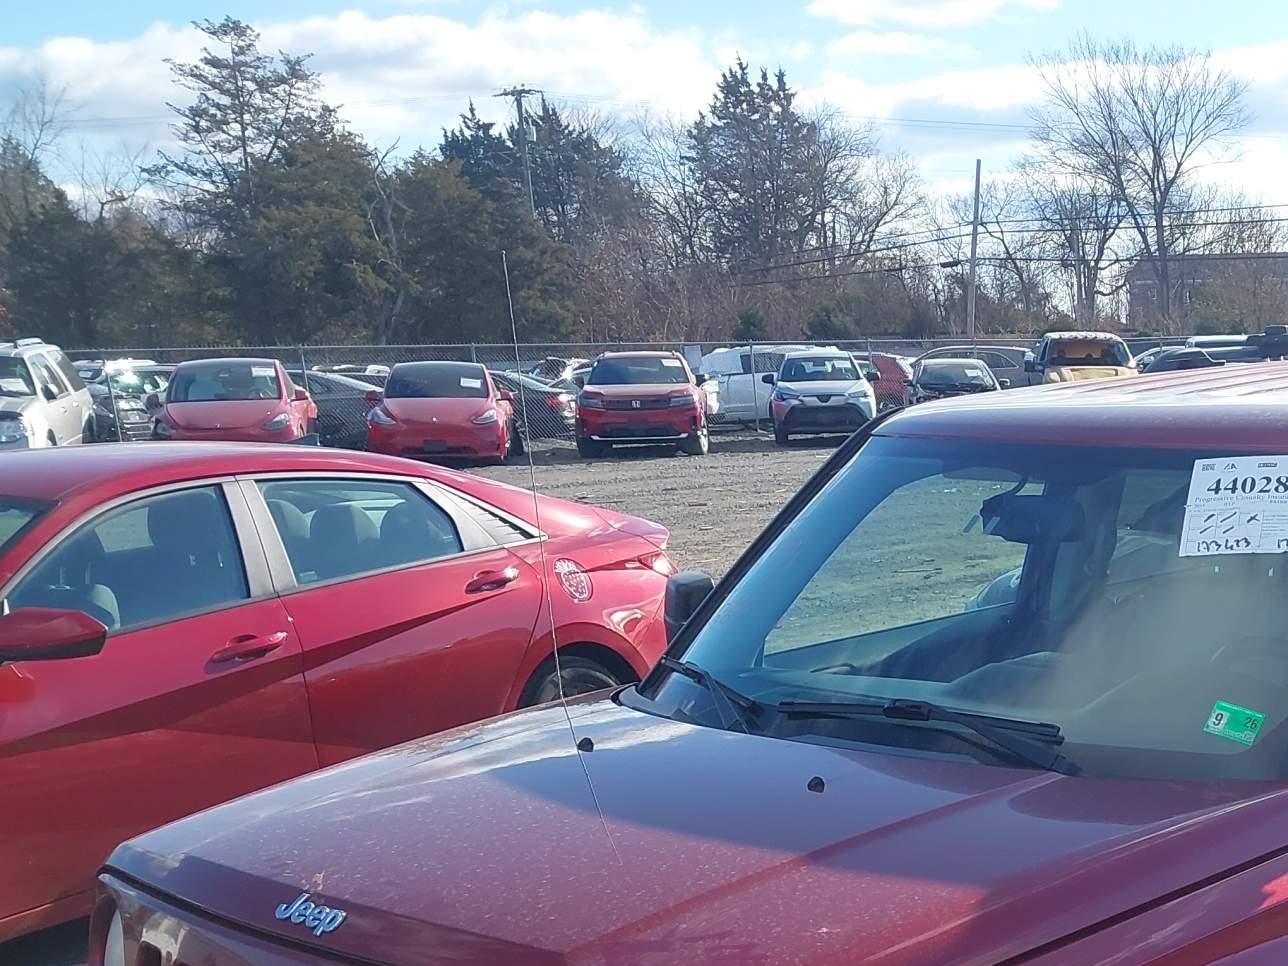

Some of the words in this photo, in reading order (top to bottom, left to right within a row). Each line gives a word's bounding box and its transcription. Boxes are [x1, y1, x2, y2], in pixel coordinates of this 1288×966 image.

[1212, 712, 1224, 727] 9
[1243, 716, 1260, 730] 26
[274, 892, 347, 937] Jeep
